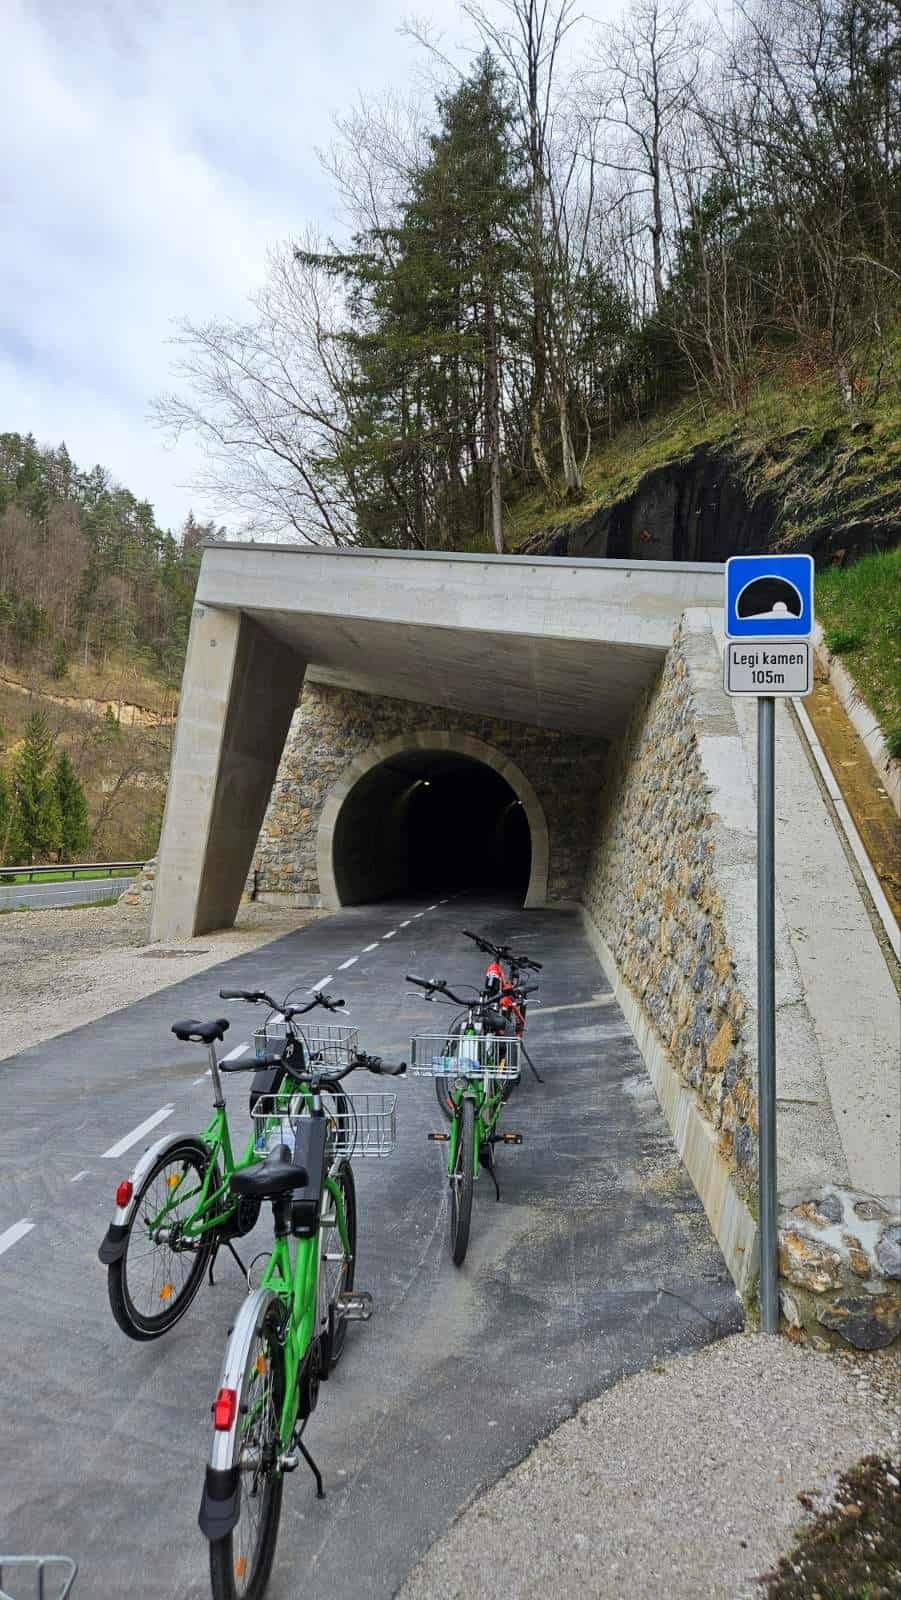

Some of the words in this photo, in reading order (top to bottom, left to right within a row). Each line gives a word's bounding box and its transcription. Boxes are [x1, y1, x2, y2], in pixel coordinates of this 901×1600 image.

[733, 651, 758, 667] Legi
[763, 651, 803, 664] kamen
[752, 671, 784, 683] 105m
